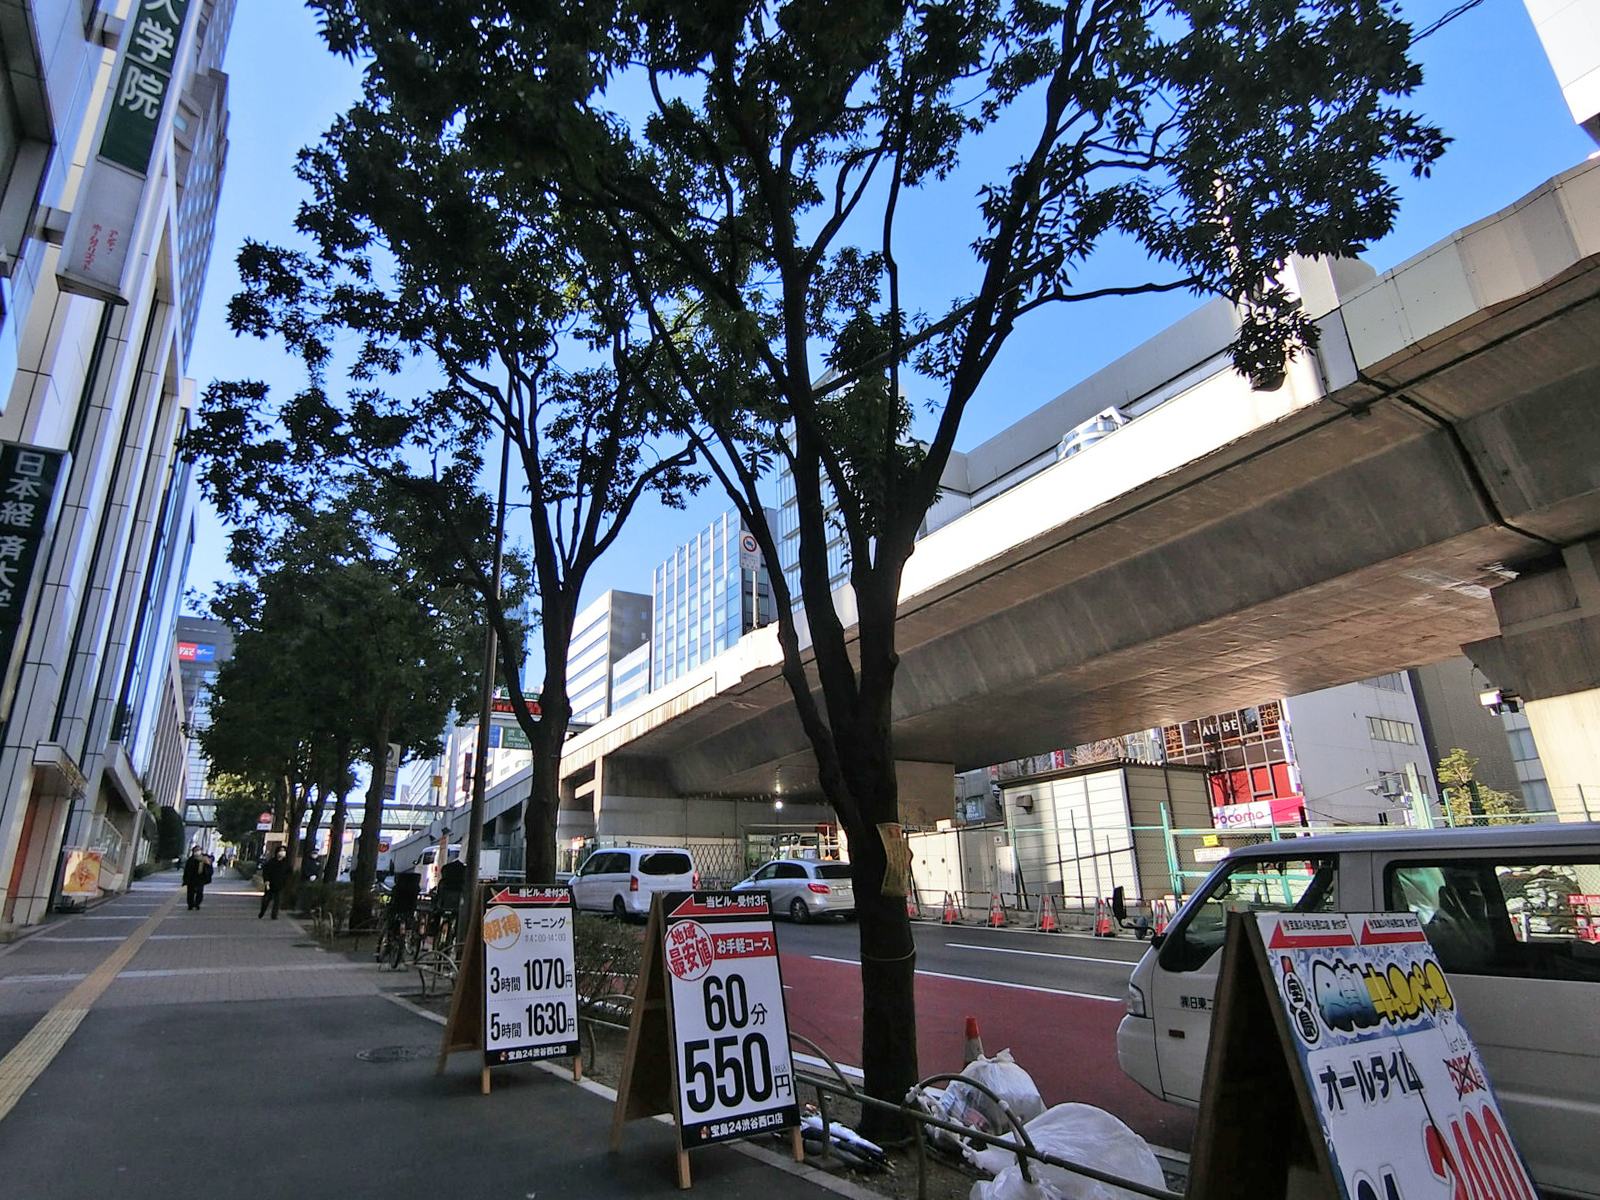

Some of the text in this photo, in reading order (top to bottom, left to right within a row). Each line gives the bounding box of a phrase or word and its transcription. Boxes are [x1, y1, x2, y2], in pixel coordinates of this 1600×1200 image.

[1213, 810, 1264, 826] docomo
[737, 895, 767, 908] 受付3F
[524, 916, 567, 930] モーニング
[671, 923, 698, 946] 地域
[669, 937, 713, 979] 最安値
[716, 937, 772, 955] お手軽コース
[490, 957, 574, 994] 3時間 1070円
[702, 973, 768, 1032] 60分
[490, 1001, 575, 1042] 5時間 1630円
[684, 1031, 792, 1114] 550円
[1320, 1050, 1424, 1112] オールタイム
[710, 1112, 784, 1139] 宝島24渋谷西口店
